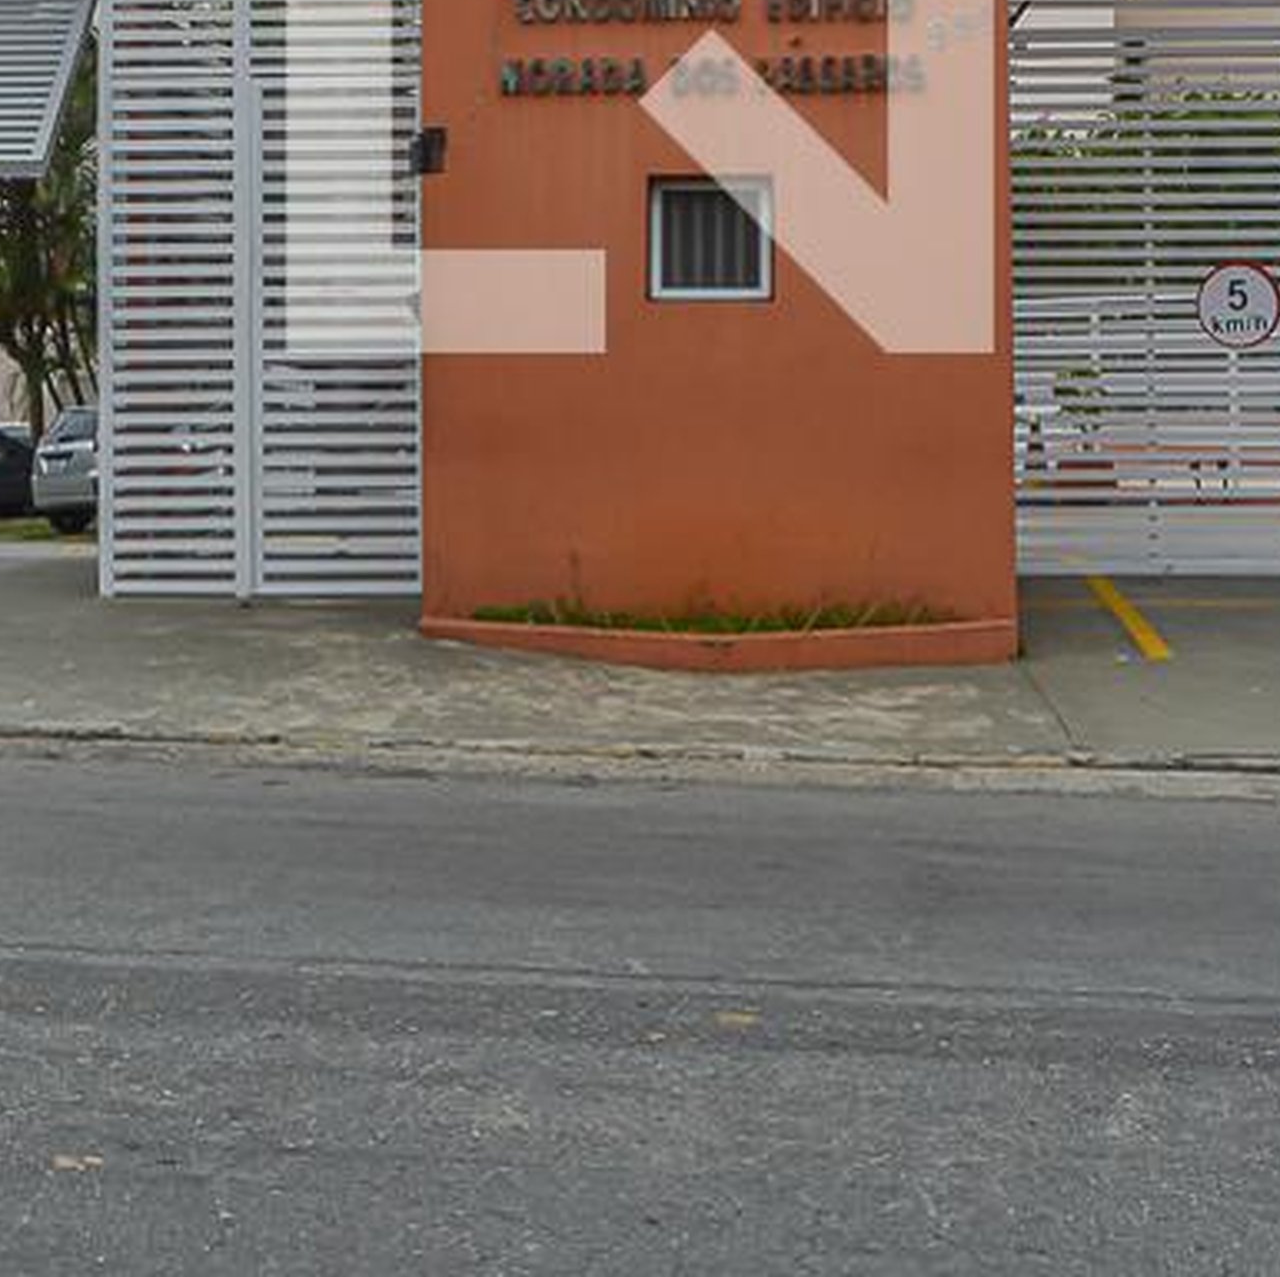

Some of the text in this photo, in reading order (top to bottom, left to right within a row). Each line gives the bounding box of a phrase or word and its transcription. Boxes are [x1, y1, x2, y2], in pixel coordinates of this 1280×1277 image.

[501, 55, 645, 95] MORADA
[1228, 279, 1248, 311] 5
[1210, 315, 1268, 334] km/h
